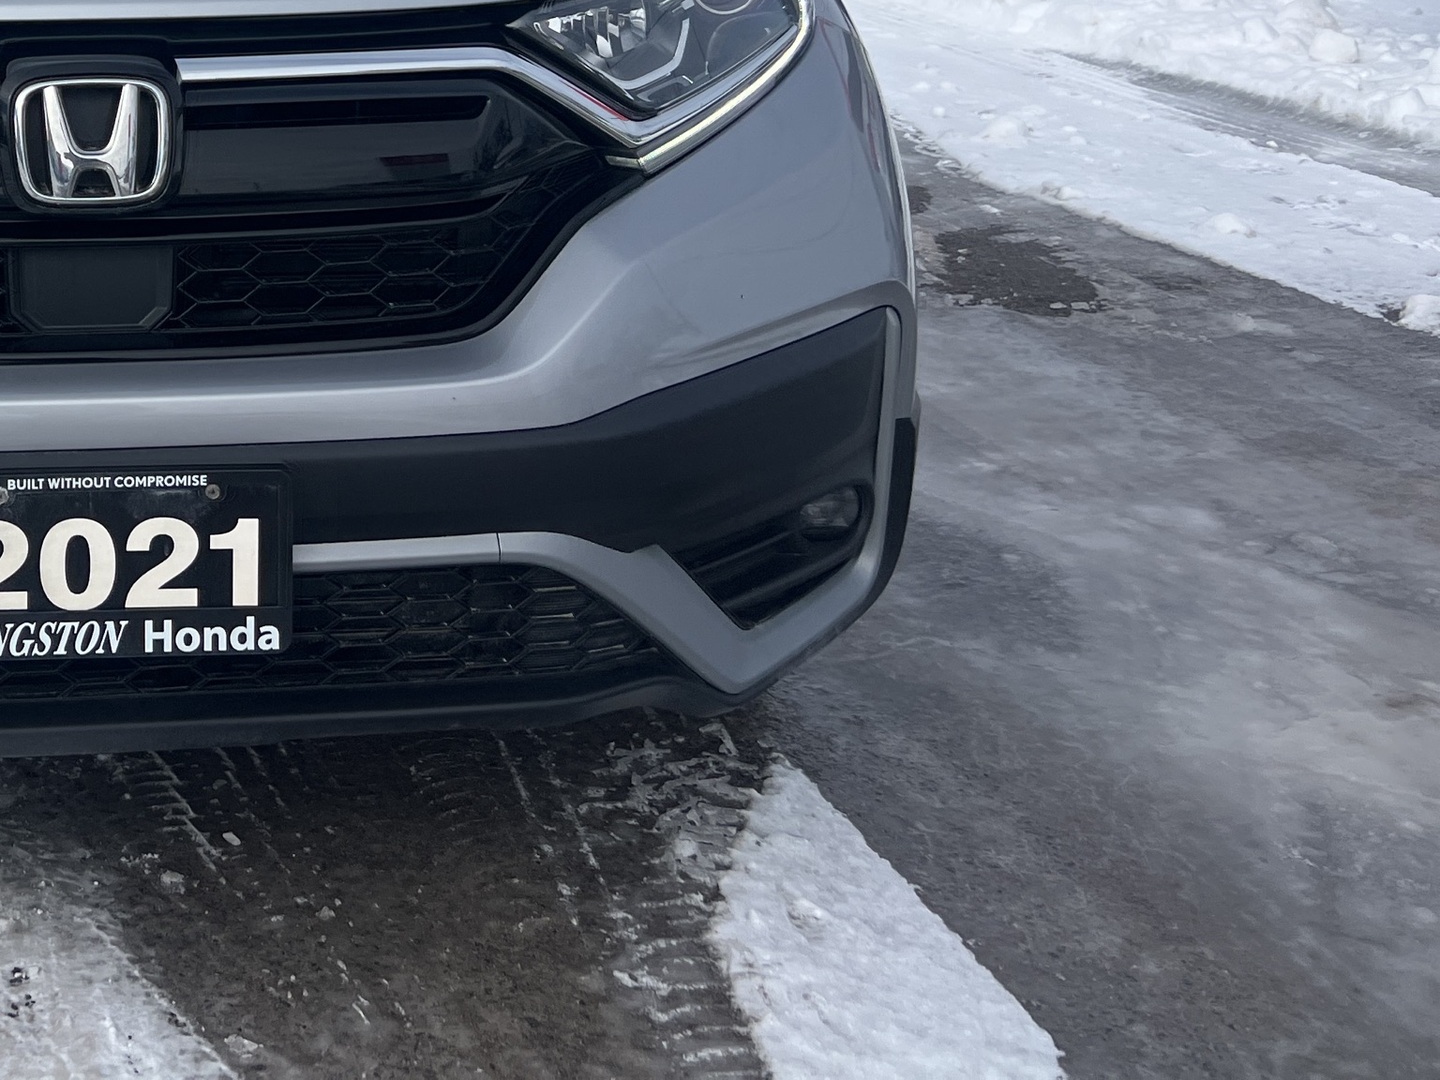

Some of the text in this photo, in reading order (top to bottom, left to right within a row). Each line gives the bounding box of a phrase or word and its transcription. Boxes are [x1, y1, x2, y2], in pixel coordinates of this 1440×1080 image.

[7, 475, 208, 490] BUILT WITHOUT COMPROMISE
[144, 616, 281, 653] Honda
